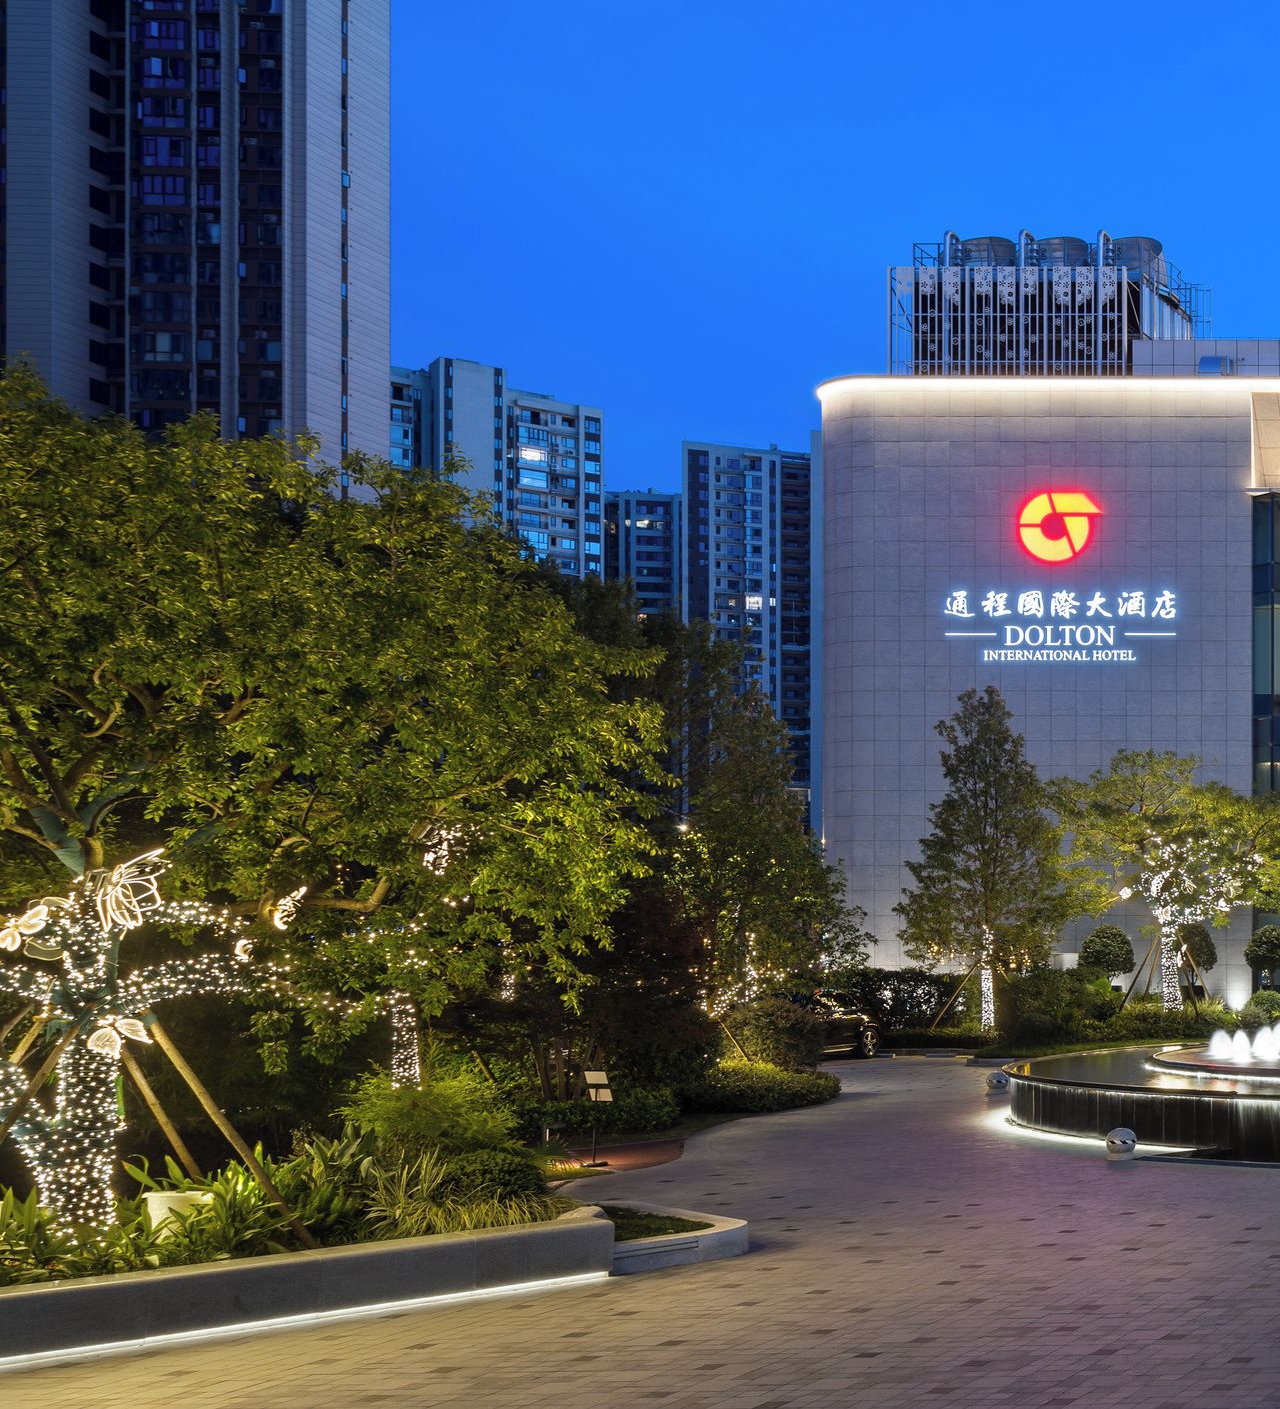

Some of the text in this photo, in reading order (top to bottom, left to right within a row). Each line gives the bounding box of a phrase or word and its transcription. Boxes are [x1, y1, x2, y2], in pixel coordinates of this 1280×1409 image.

[944, 590, 1176, 619] 通程國際大酒店
[1004, 625, 1115, 646] DOLTON
[984, 650, 1136, 661] INTERNATIONAL HOTEL
